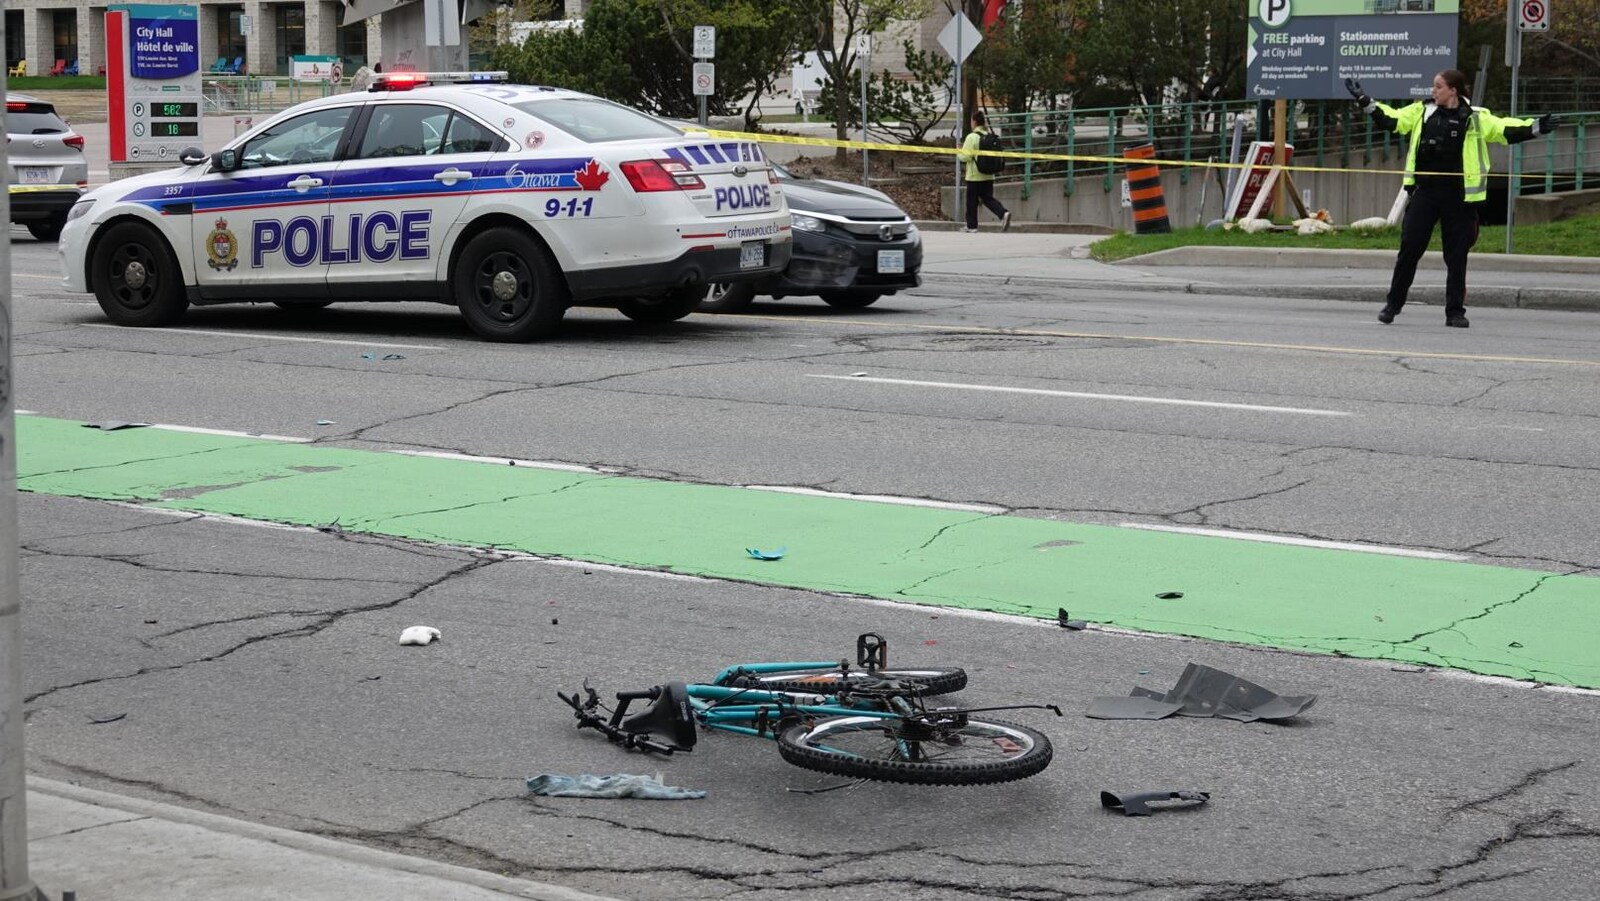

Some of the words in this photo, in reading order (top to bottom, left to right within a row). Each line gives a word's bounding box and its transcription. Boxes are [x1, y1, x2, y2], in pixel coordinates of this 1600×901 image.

[136, 27, 154, 40] City
[155, 27, 173, 38] Hall
[1262, 33, 1289, 44] FREE
[1290, 34, 1326, 46] parking
[1340, 30, 1409, 41] Stationnement
[137, 41, 161, 52] Hôtel
[162, 41, 174, 52] de
[175, 42, 194, 52] ville
[1340, 44, 1389, 56] GRATUIT
[1422, 46, 1434, 56] de
[1434, 45, 1452, 56] ville
[1262, 49, 1271, 58] at
[1271, 48, 1286, 60] City
[1287, 47, 1303, 58] Hall
[504, 162, 561, 188] Ottawa
[163, 185, 183, 196] 3357
[714, 184, 771, 211] POLICE
[543, 196, 594, 218] 9-1-1
[251, 209, 433, 269] POLICE
